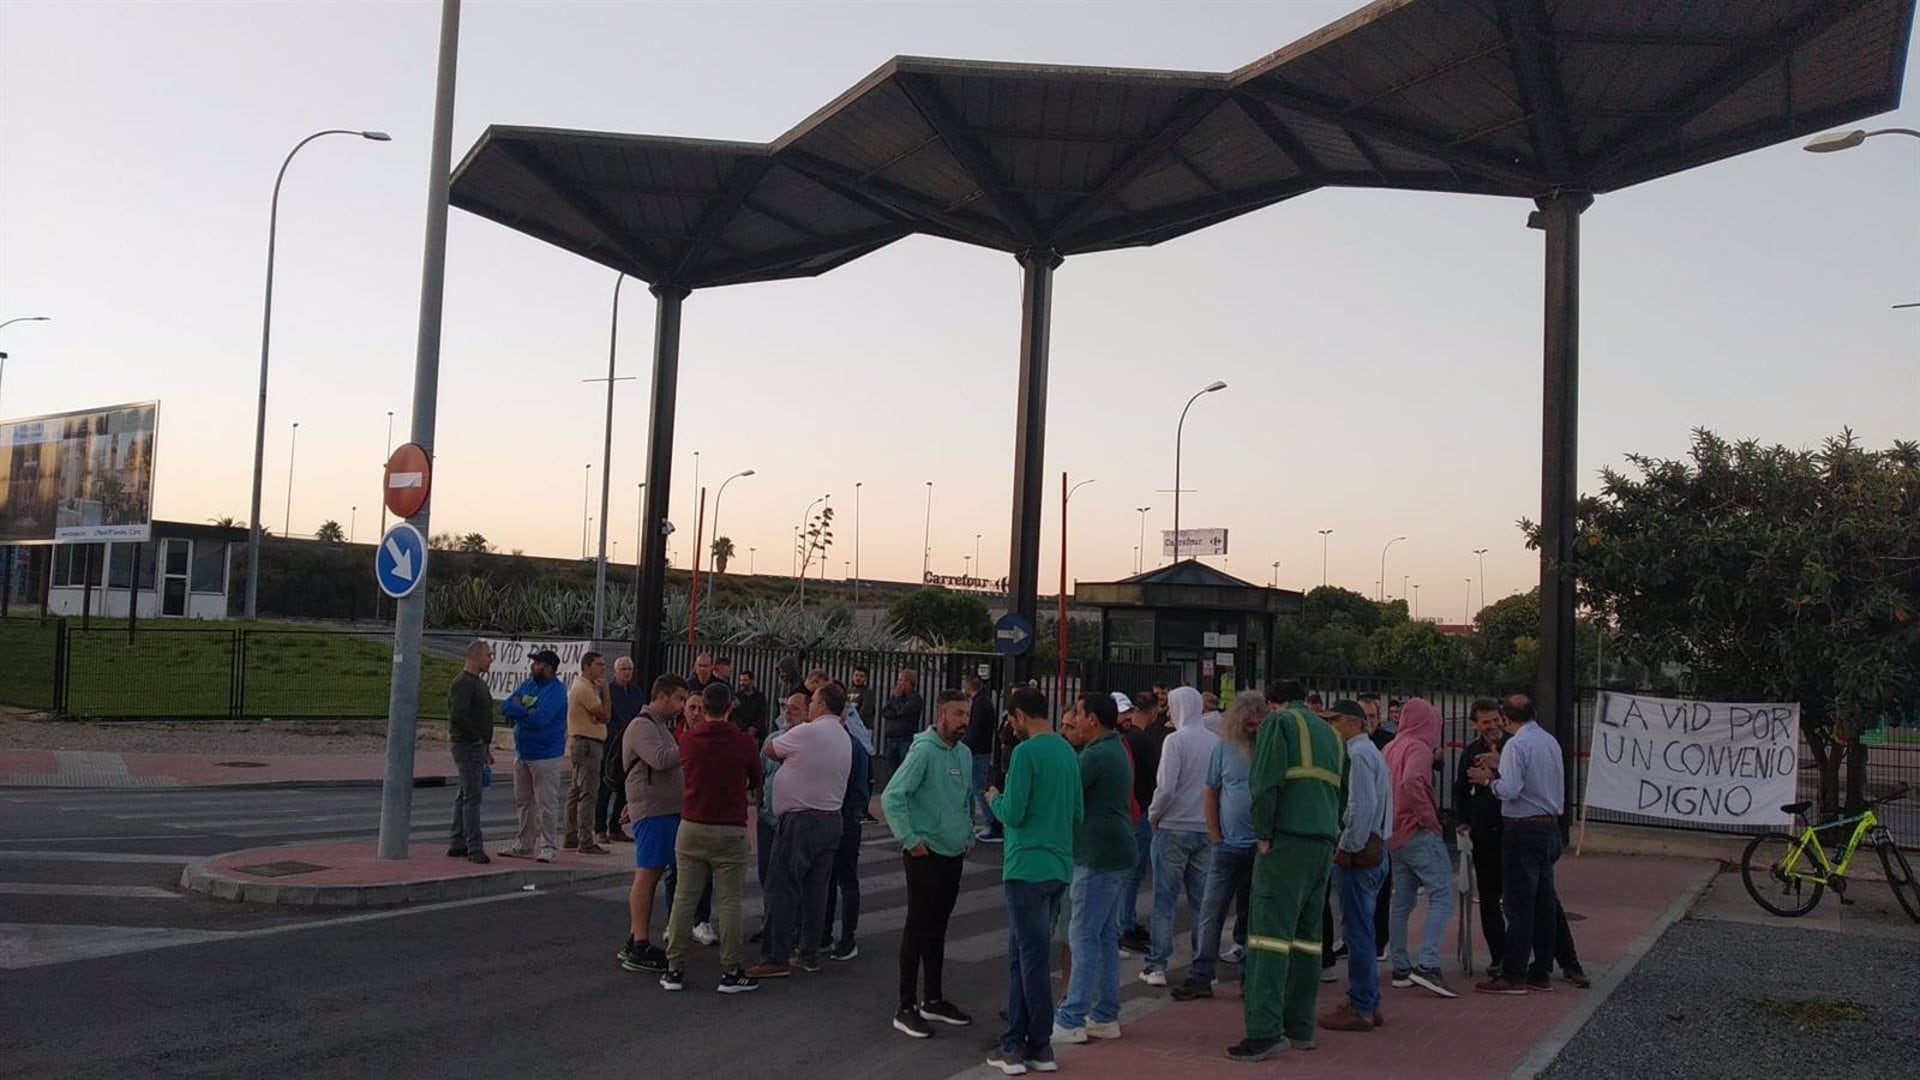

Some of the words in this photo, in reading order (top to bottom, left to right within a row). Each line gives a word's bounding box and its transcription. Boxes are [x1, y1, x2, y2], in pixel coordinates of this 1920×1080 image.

[1165, 537, 1203, 547] Carefour
[924, 571, 989, 588] Carrefour
[500, 642, 524, 665] VID
[562, 643, 584, 665] UN
[1601, 693, 1649, 731] LA
[1730, 706, 1793, 741] POR
[1603, 732, 1653, 770] UN
[1639, 779, 1752, 816] DIGNO
